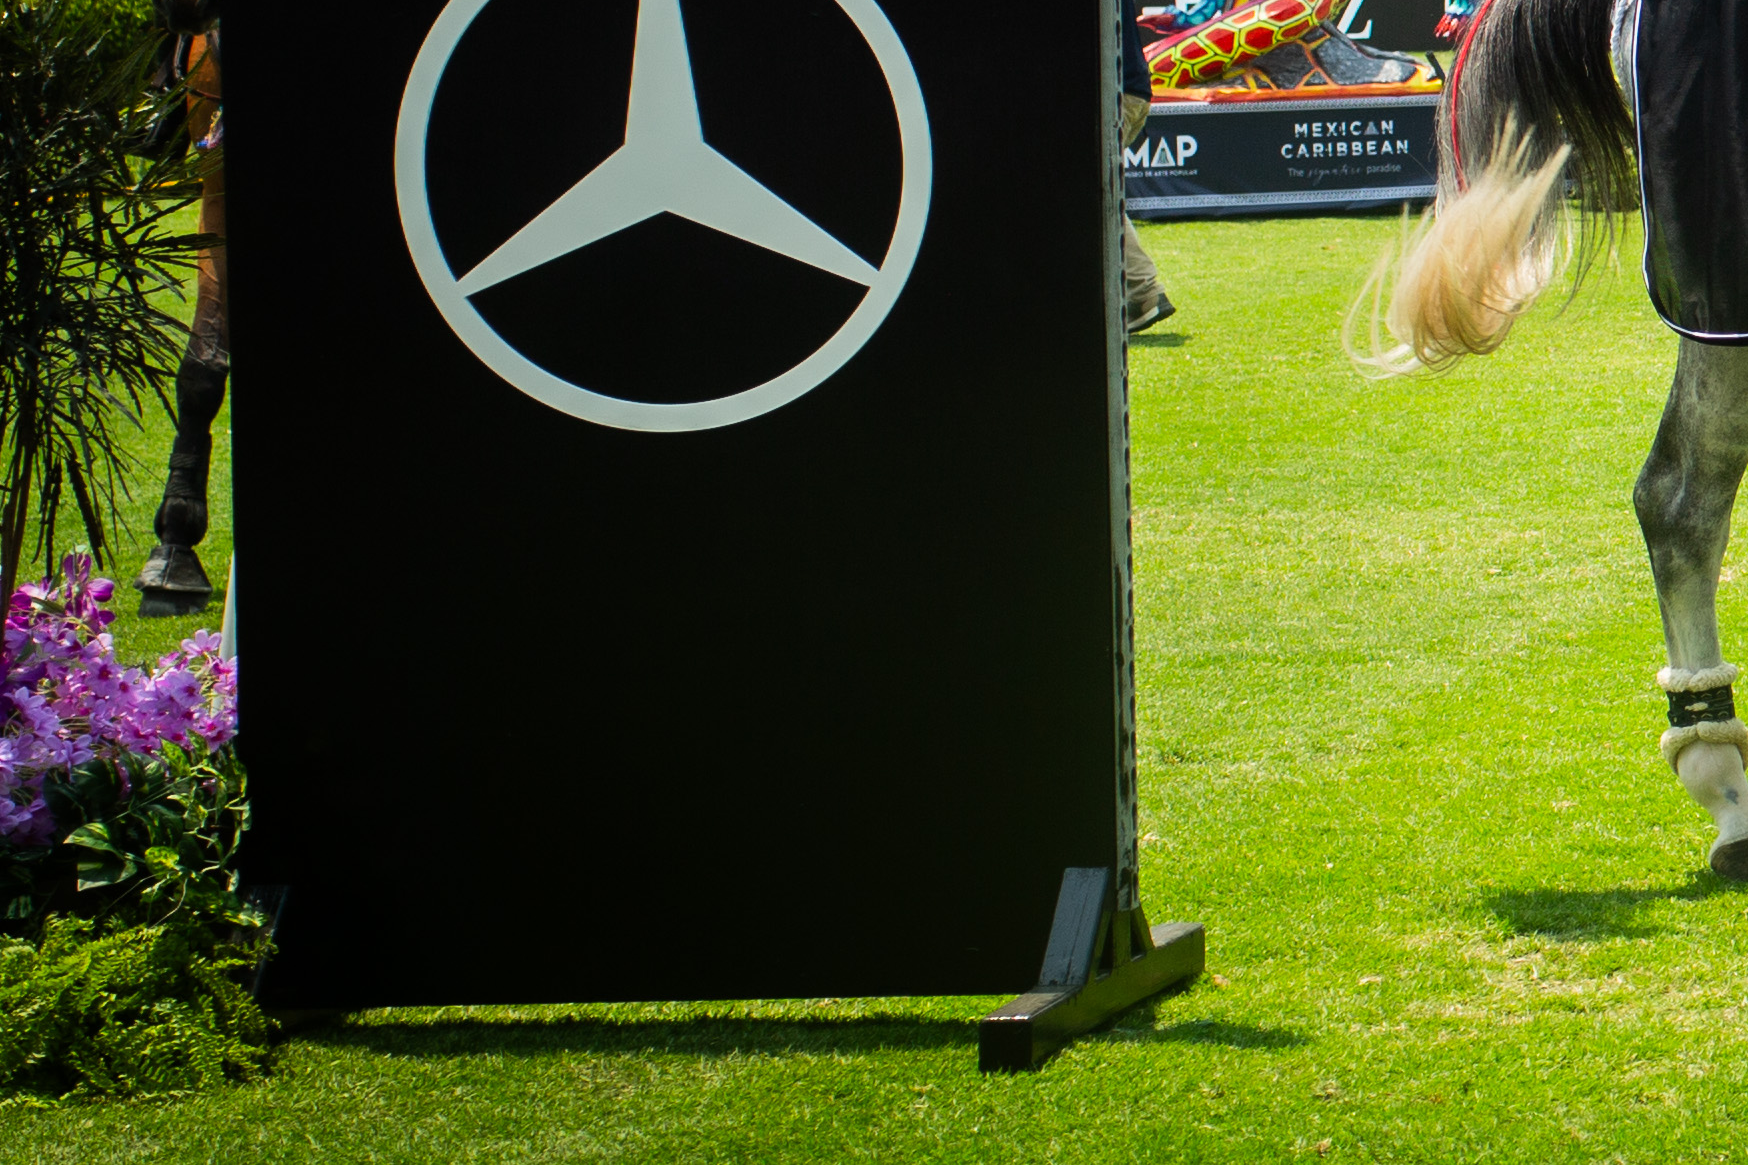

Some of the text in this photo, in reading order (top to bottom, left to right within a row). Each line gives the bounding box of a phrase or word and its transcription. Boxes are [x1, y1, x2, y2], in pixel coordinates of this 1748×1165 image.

[1294, 119, 1394, 139] MEXICAN
[1280, 139, 1409, 159] CARIBBEAN
[1287, 166, 1305, 178] The
[1366, 163, 1402, 175] paradise
